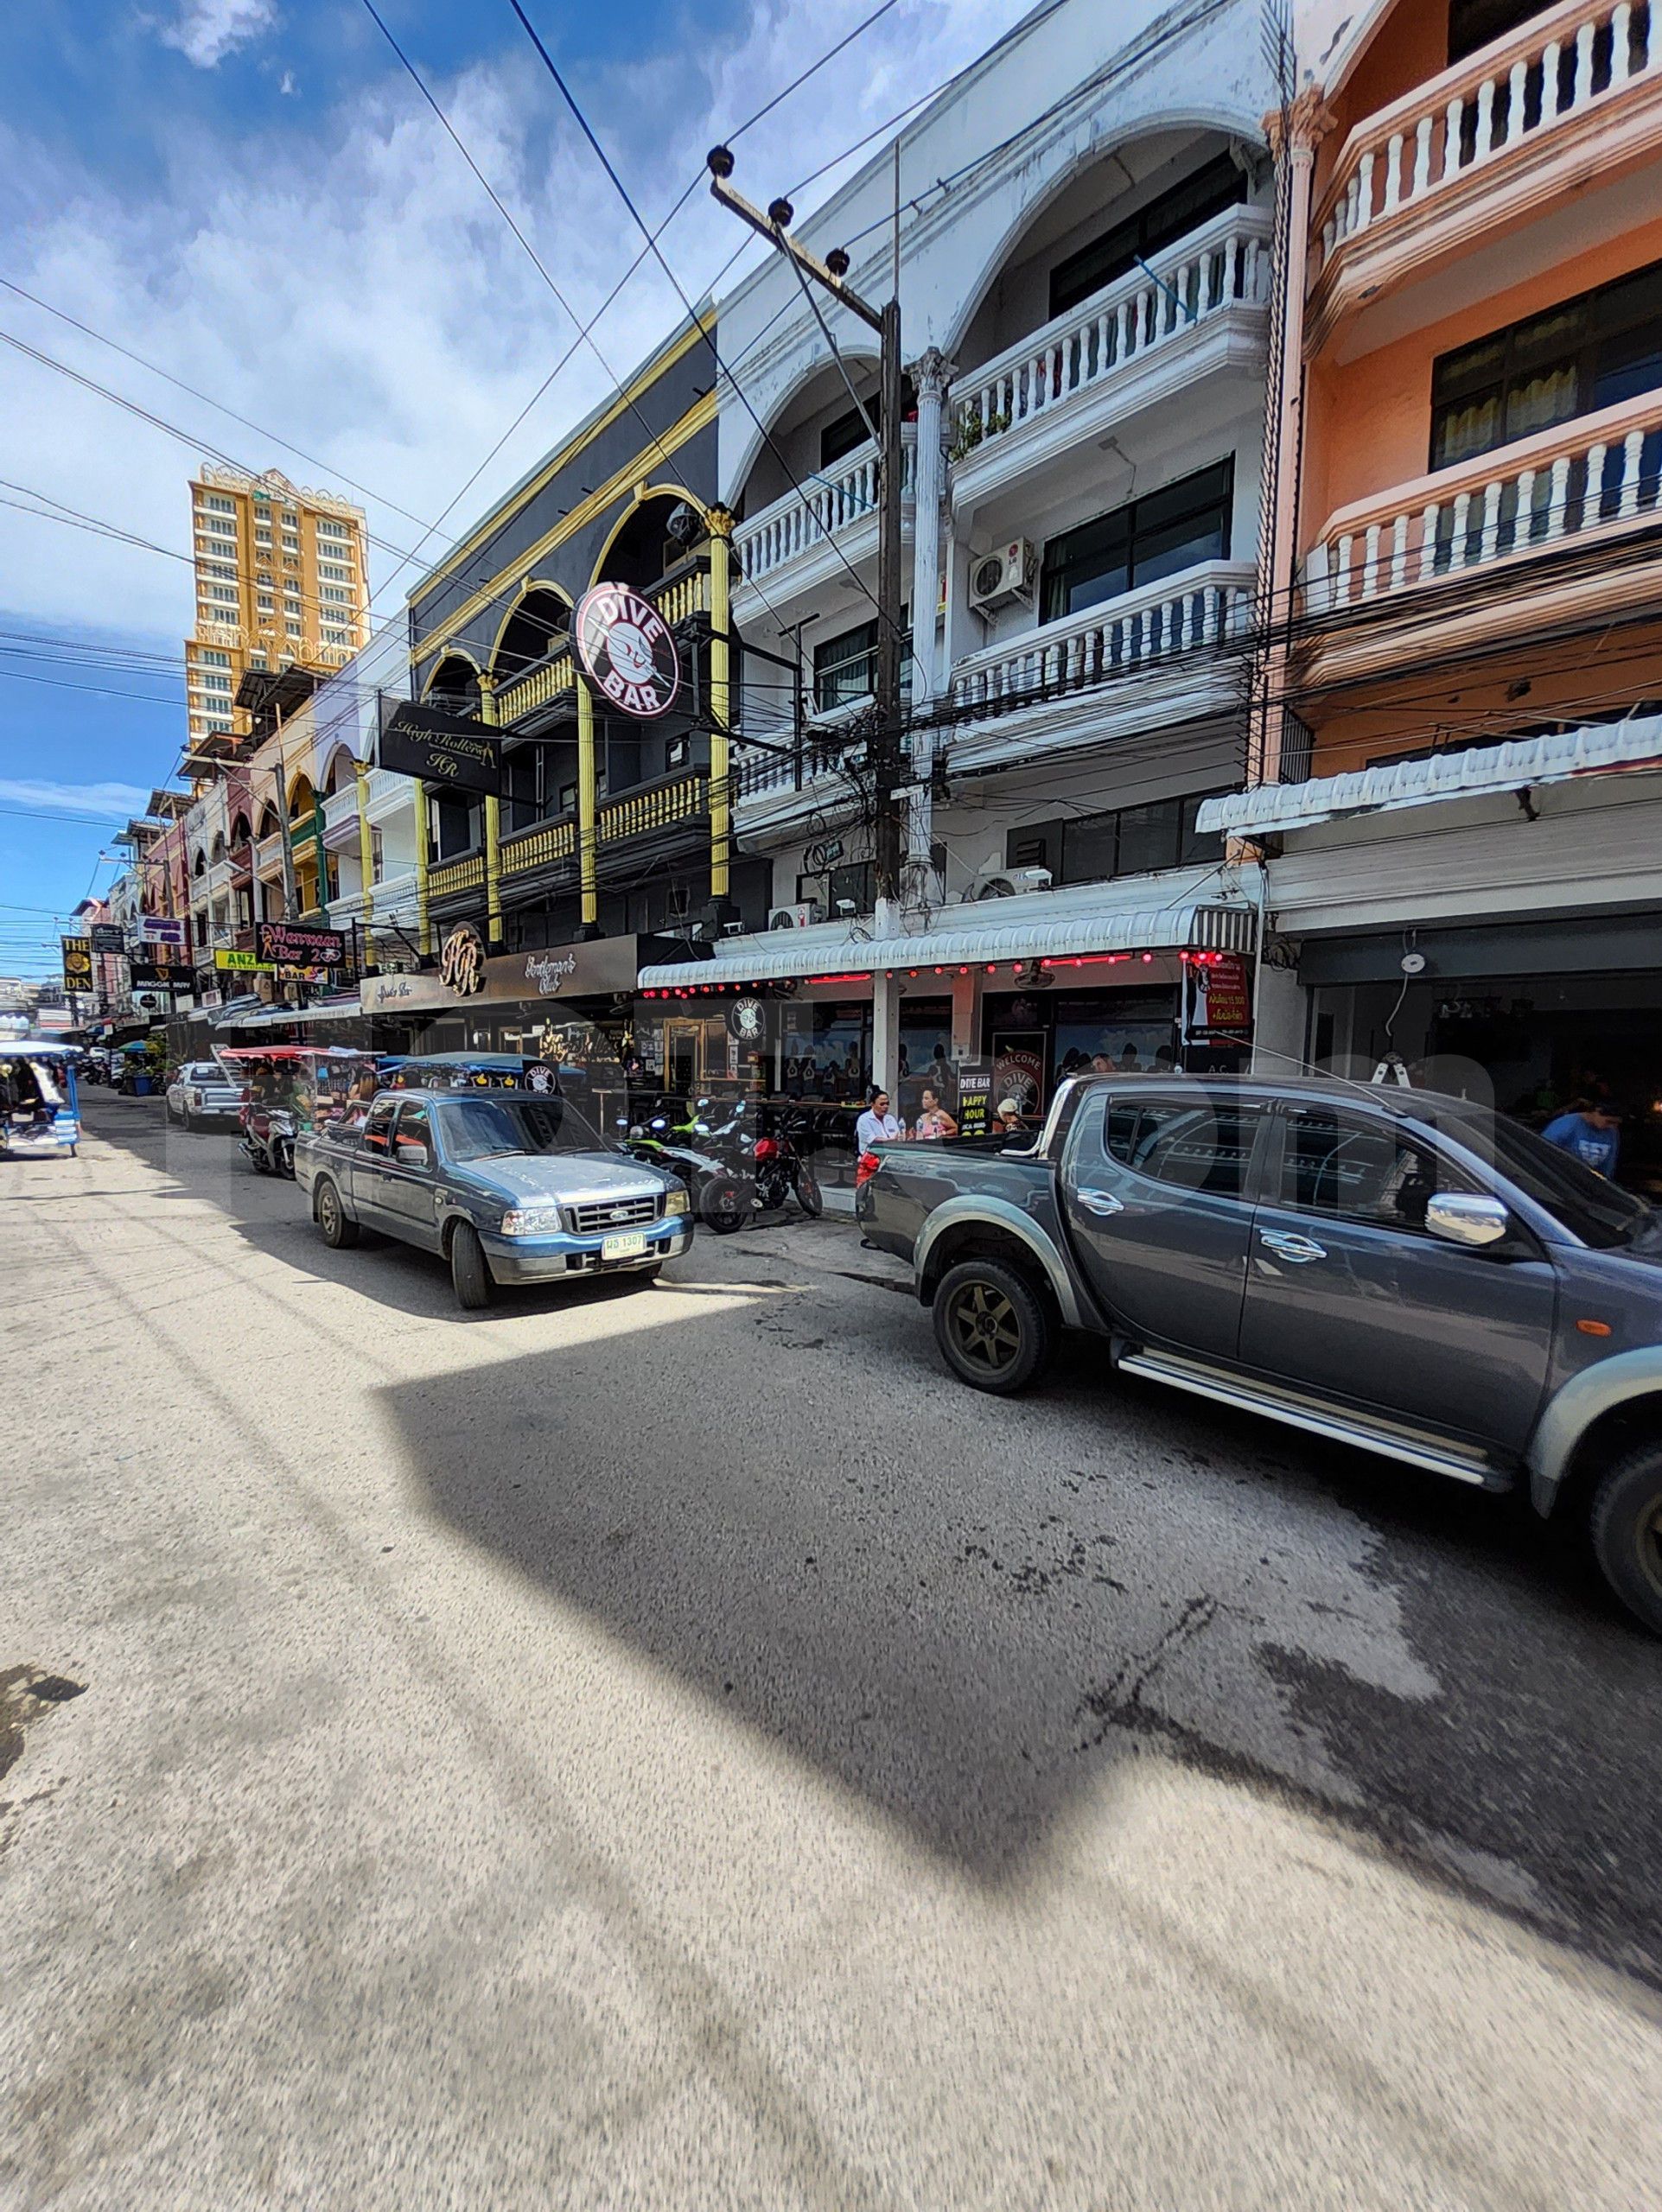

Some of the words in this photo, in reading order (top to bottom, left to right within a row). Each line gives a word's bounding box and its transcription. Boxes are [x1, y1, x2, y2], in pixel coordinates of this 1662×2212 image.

[596, 594, 664, 643] DIVE
[603, 671, 660, 710] BAR
[395, 721, 432, 742] High
[435, 734, 484, 755] Rollers
[64, 938, 89, 951] THE
[227, 953, 268, 966] ANZ
[272, 944, 302, 961] Bar
[311, 948, 321, 962] 2
[285, 970, 305, 980] BAR
[67, 976, 92, 989] DEN
[736, 998, 760, 1012] DIVE
[740, 1027, 758, 1038] BAR
[996, 1053, 1041, 1071] WELCOME
[529, 1066, 551, 1077] DIVE
[977, 1077, 990, 1089] BAR
[1003, 1072, 1033, 1090] DIVE
[963, 1095, 987, 1107] HAPPY
[964, 1109, 984, 1120] HOUR
[622, 1235, 642, 1249] 1307
